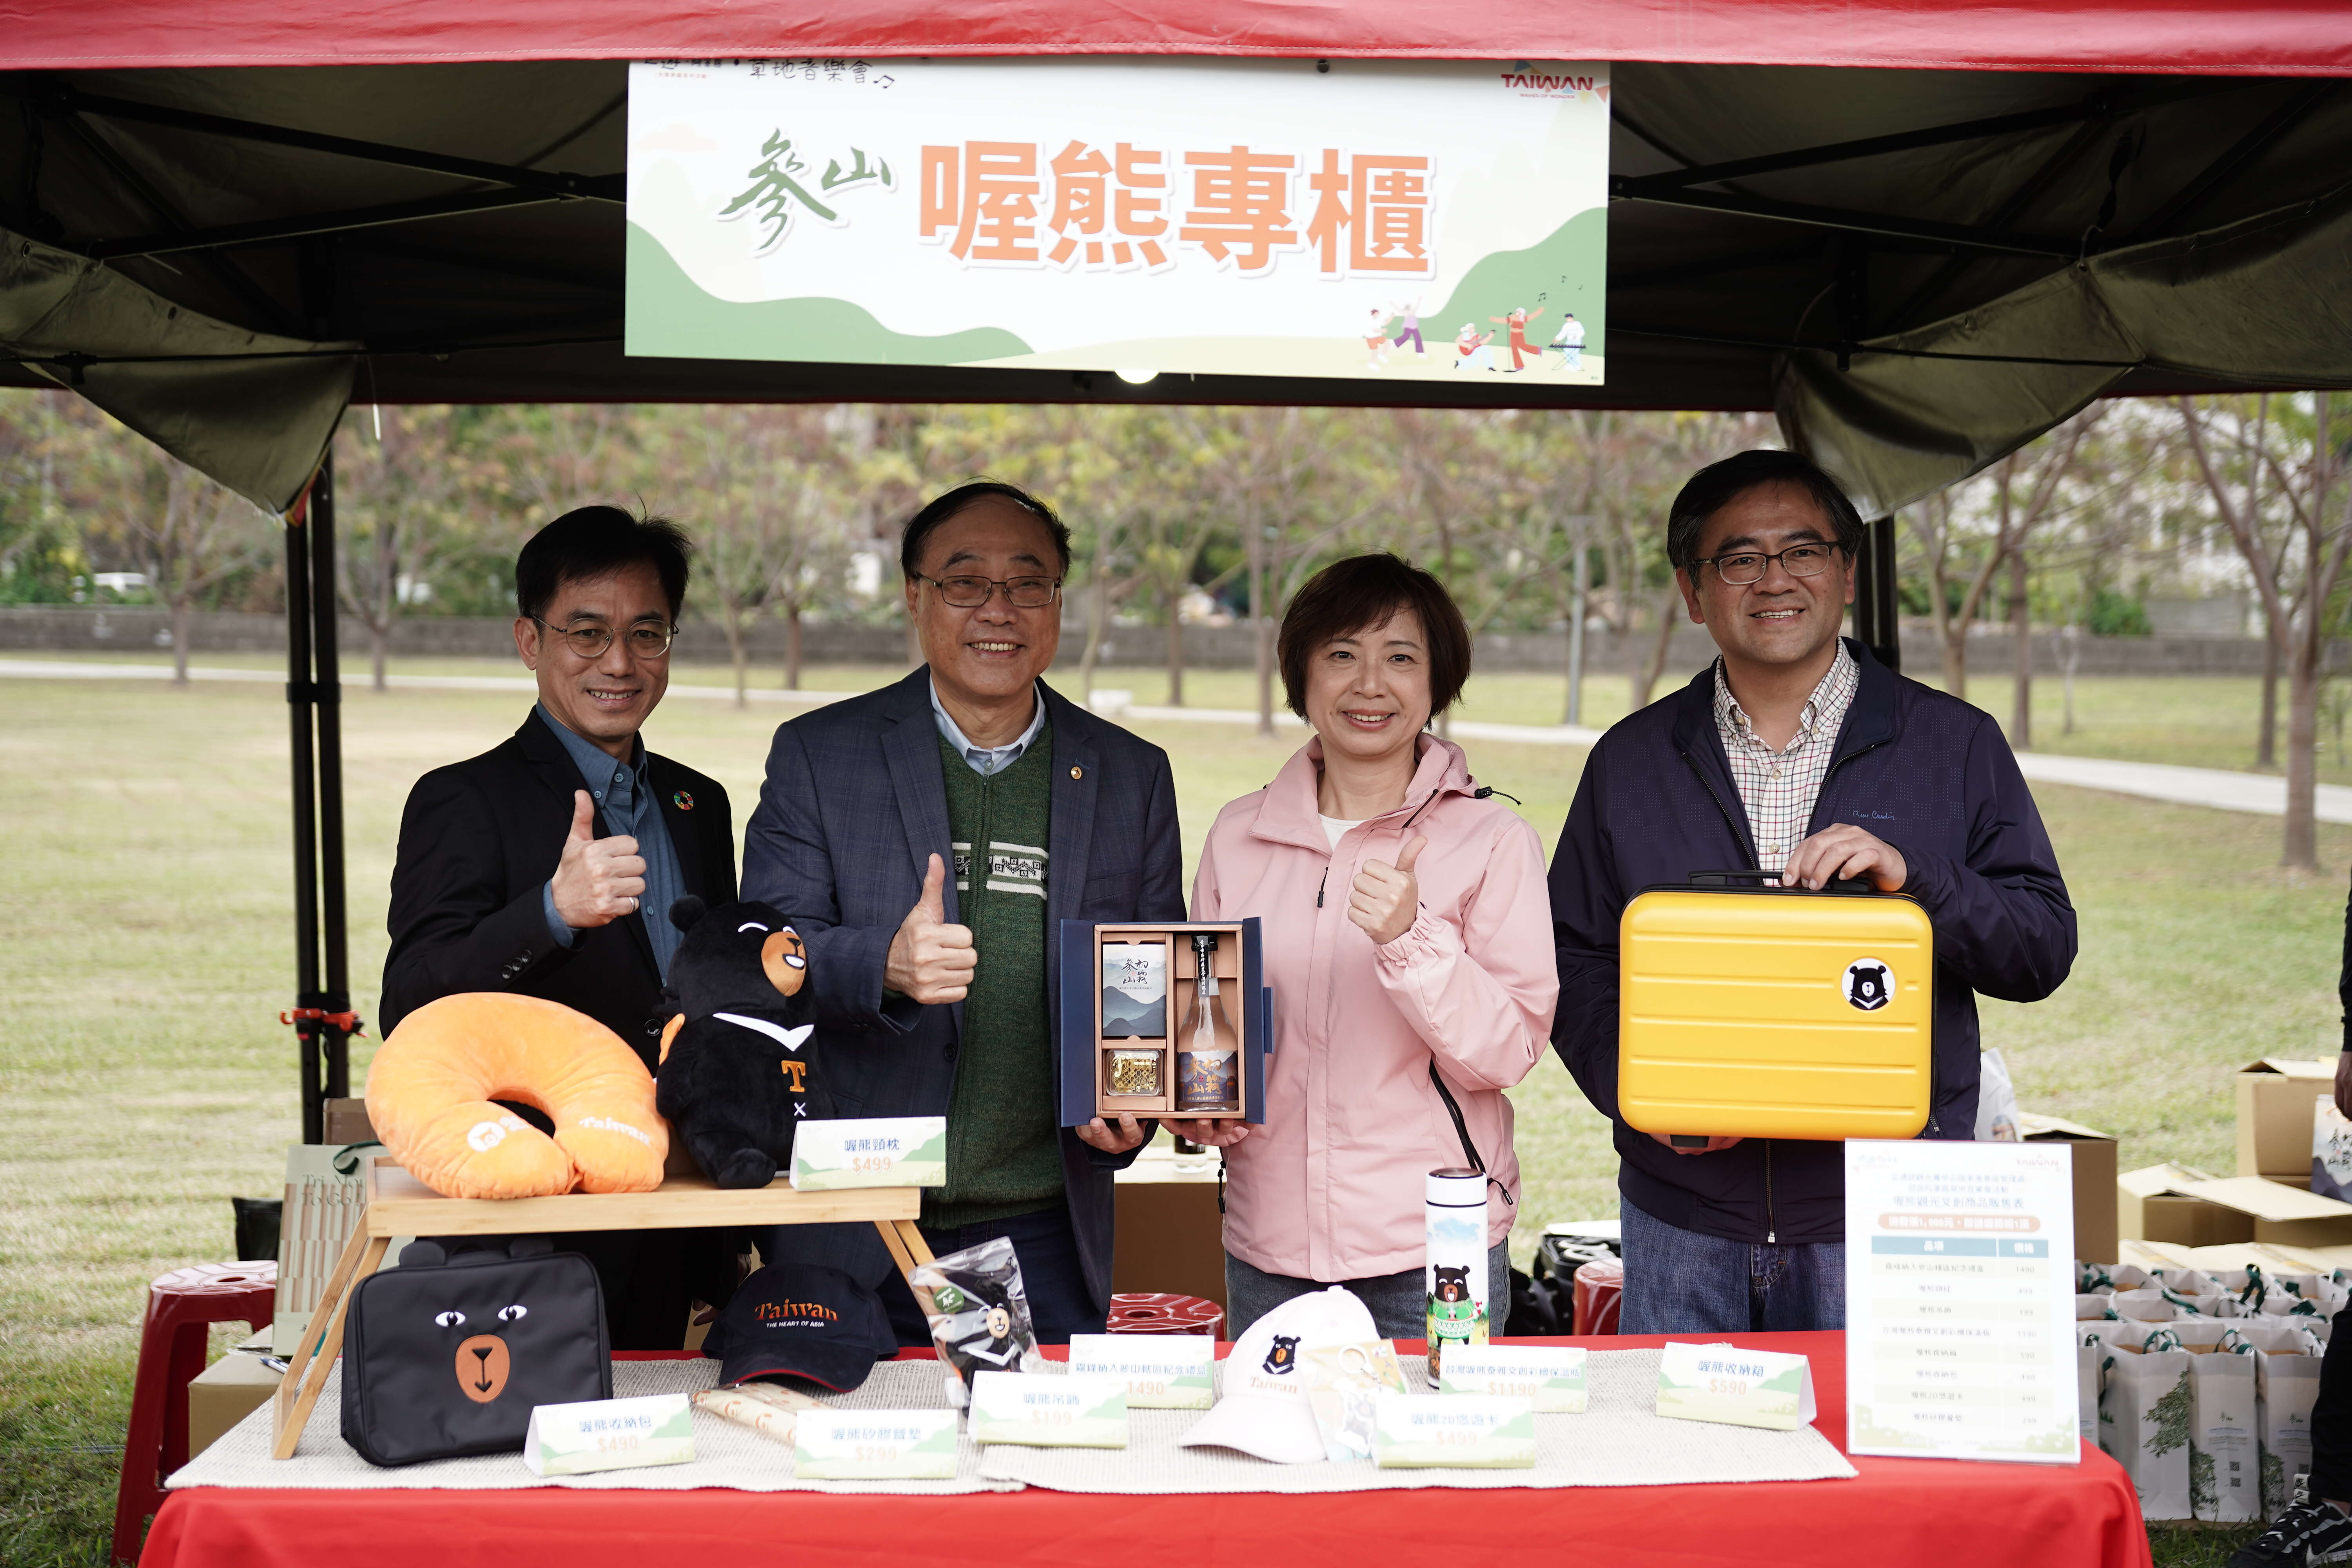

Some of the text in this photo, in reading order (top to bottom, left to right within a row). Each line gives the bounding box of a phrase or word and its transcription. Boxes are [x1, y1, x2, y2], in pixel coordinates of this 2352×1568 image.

[748, 58, 873, 83] 草地音樂會
[1501, 74, 1593, 91] TAIWAN
[920, 140, 1428, 273] 喔熊專櫃
[780, 1060, 806, 1093] T
[579, 1116, 650, 1146] Taiwan
[844, 1138, 900, 1152] 喔熊頸枕
[853, 1157, 892, 1172] $499
[2016, 1265, 2035, 1274] 1490
[754, 1298, 839, 1322] Taiwan
[1698, 1360, 1765, 1377] 喔熊收納箱
[1249, 1376, 1298, 1394] Taiwan
[1487, 1381, 1537, 1396] $1190
[1709, 1378, 1747, 1395] $590
[1023, 1393, 1080, 1406] 喔熊吊飾
[579, 1416, 652, 1433] 喔熊收納包
[1032, 1410, 1072, 1425] $199
[597, 1436, 639, 1453] $490
[1436, 1431, 1477, 1446] $499
[855, 1446, 897, 1462] $299
